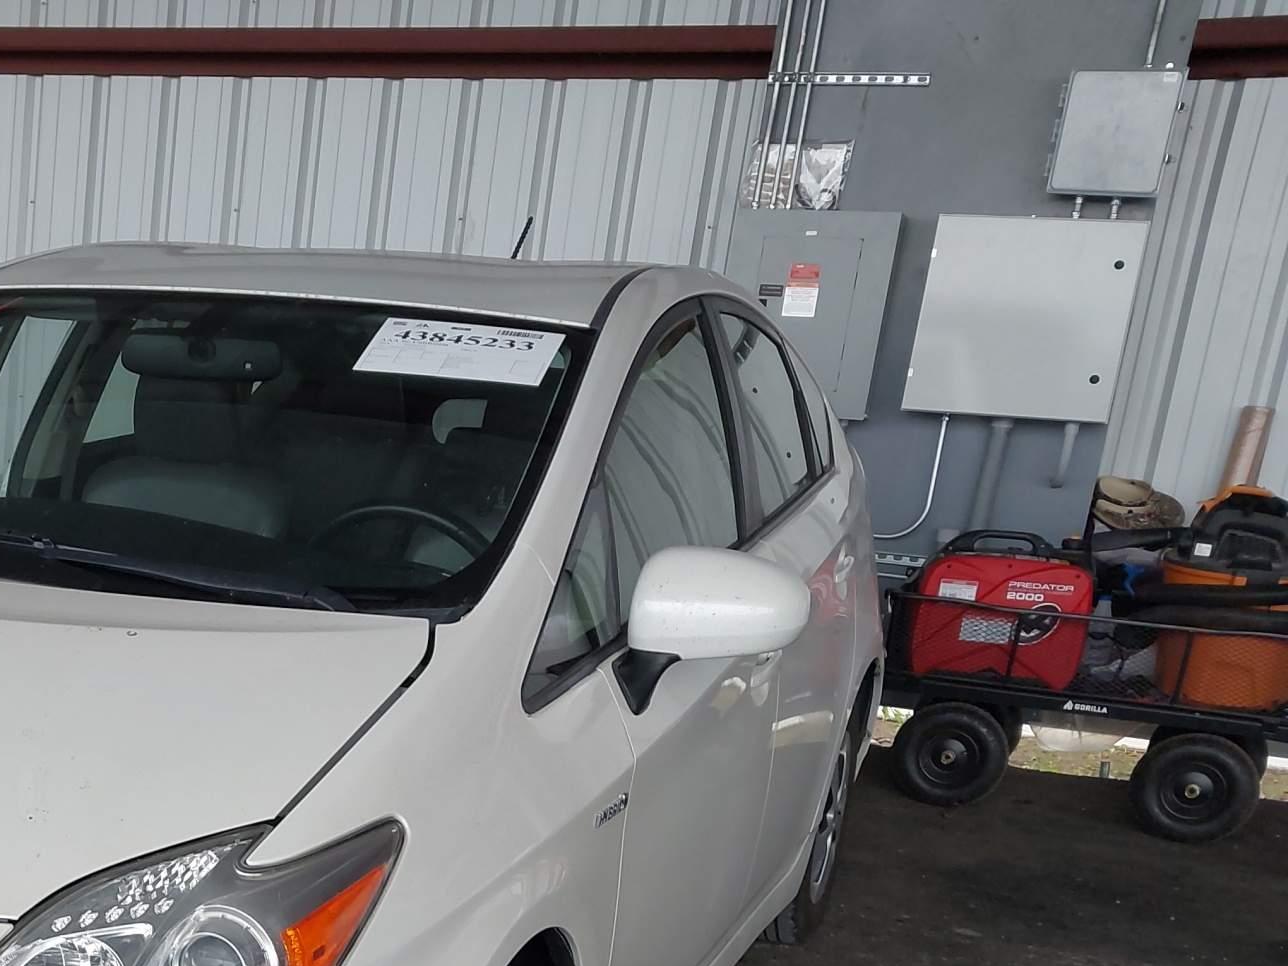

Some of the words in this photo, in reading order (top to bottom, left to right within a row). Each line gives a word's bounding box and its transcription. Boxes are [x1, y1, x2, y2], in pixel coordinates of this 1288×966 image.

[394, 329, 535, 350] 43845233
[1008, 581, 1074, 591] PREDATOR
[1006, 592, 1044, 601] 2000
[1074, 703, 1108, 713] GORILLA
